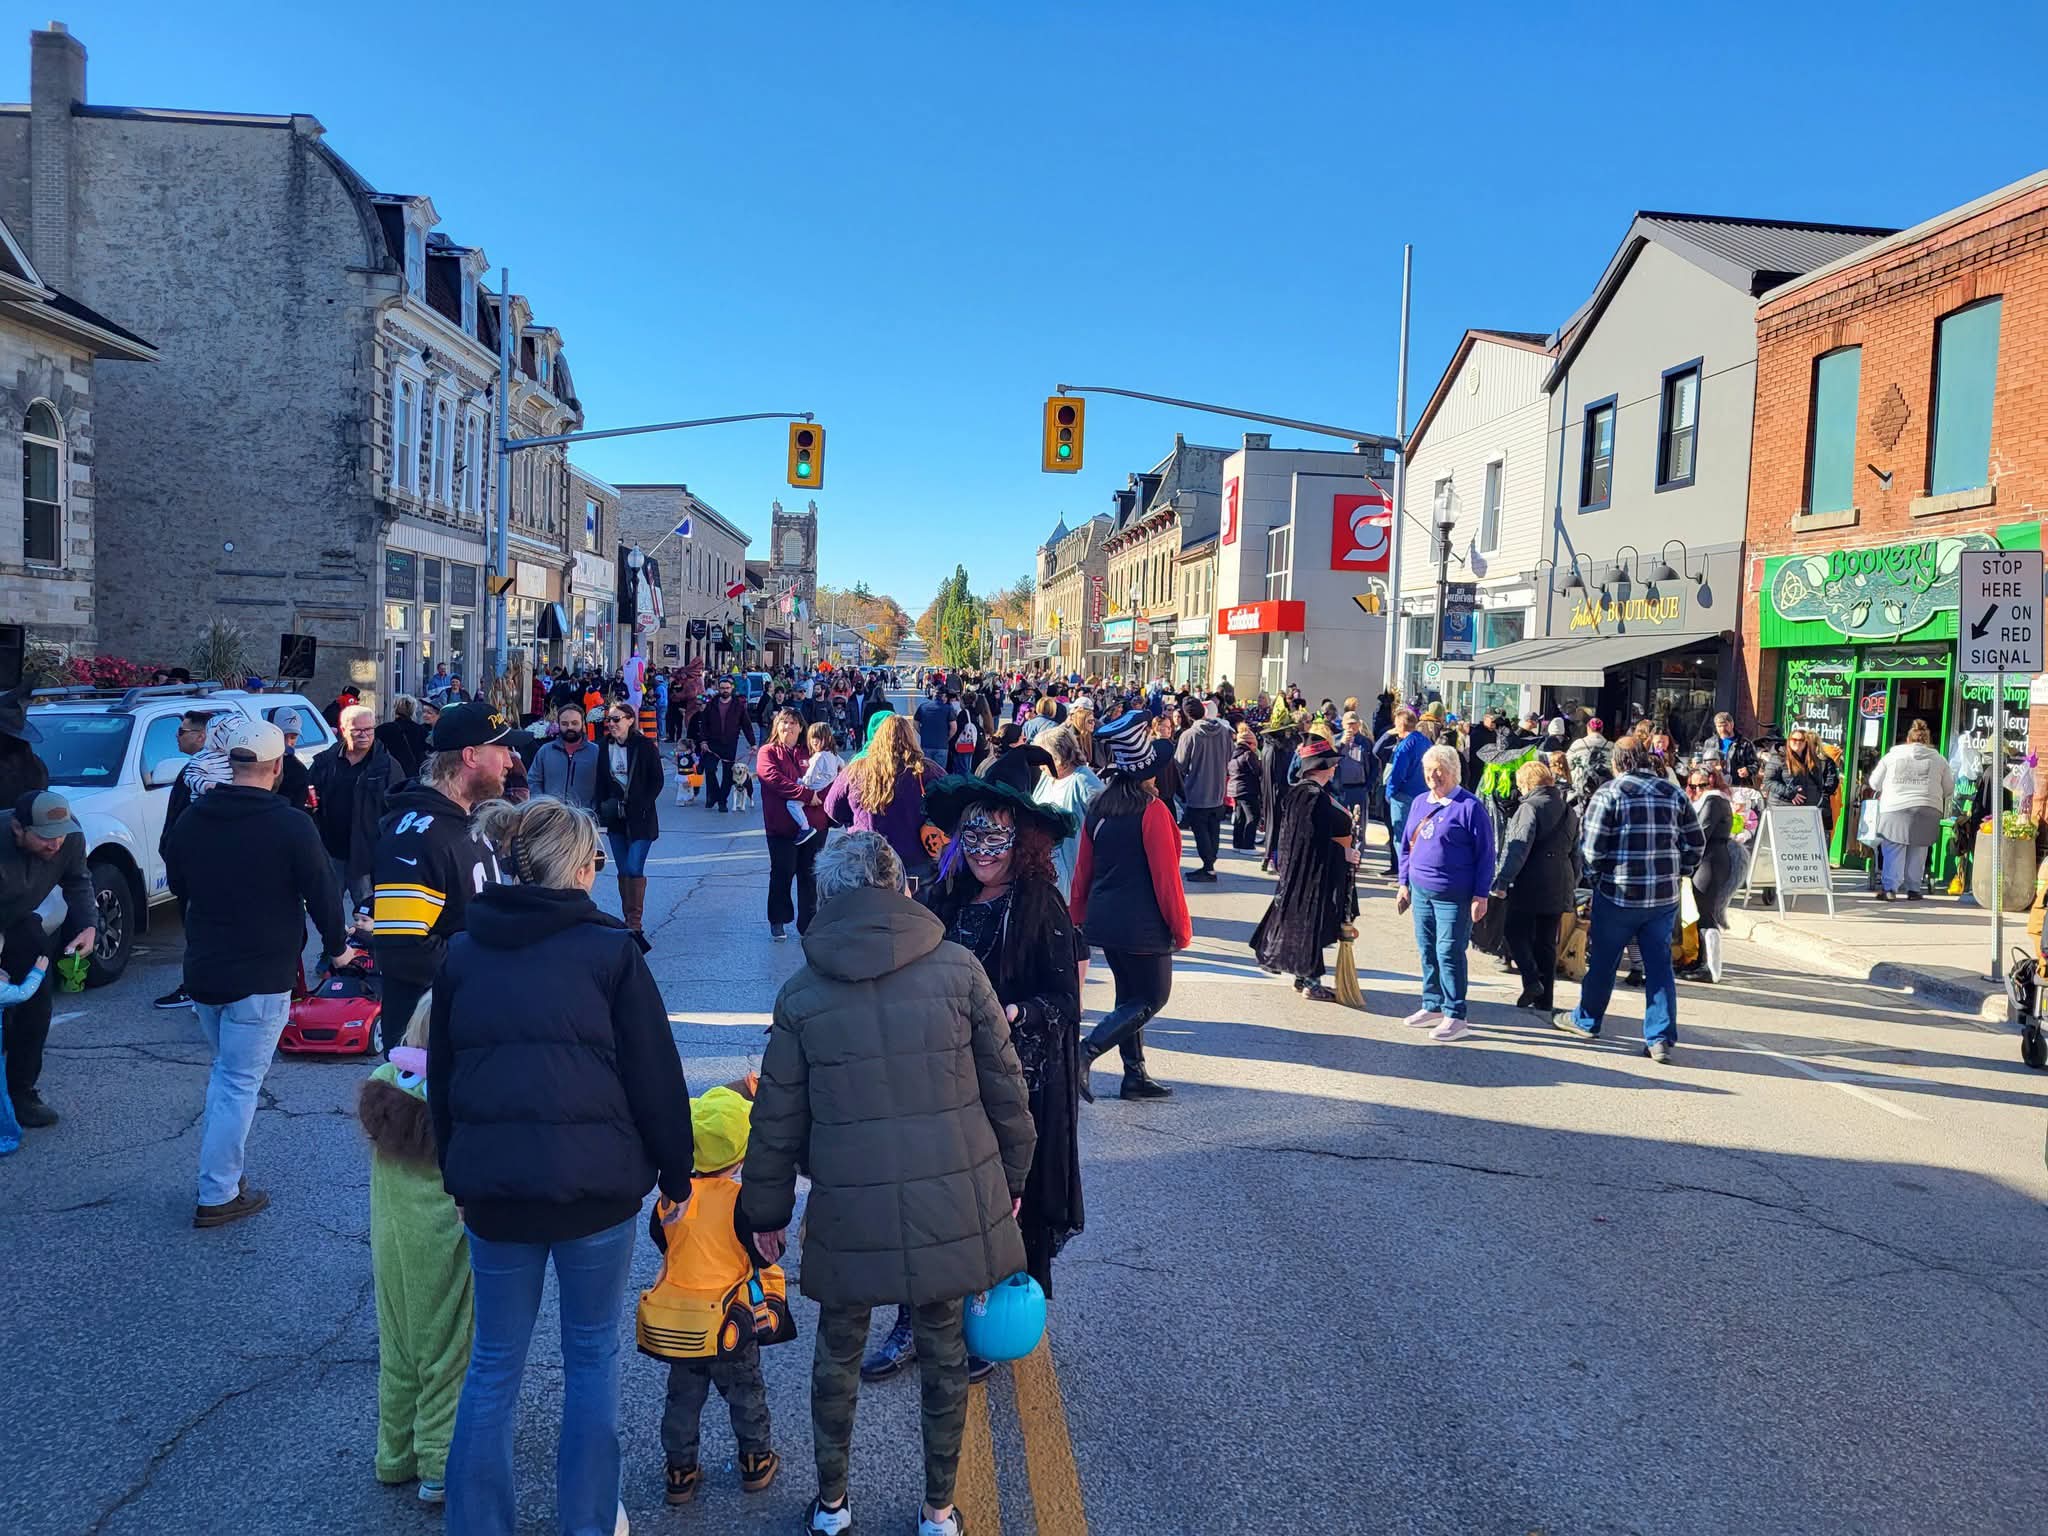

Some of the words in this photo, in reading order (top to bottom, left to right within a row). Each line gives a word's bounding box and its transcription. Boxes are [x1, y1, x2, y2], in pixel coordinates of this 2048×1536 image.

[1983, 561, 2022, 574] STOP
[1982, 582, 2021, 597] HERE
[1607, 596, 1679, 624] BOUTIQUE
[2011, 605, 2032, 620] ON
[2001, 627, 2031, 642] RED
[1971, 649, 2032, 664] SIGNAL
[1860, 696, 1888, 713] OPE
[1970, 708, 2029, 735] Jewllery
[395, 812, 435, 835] 84
[1781, 853, 1808, 861] COME
[1811, 853, 1822, 861] IN
[1790, 875, 1819, 883] OPEN!
